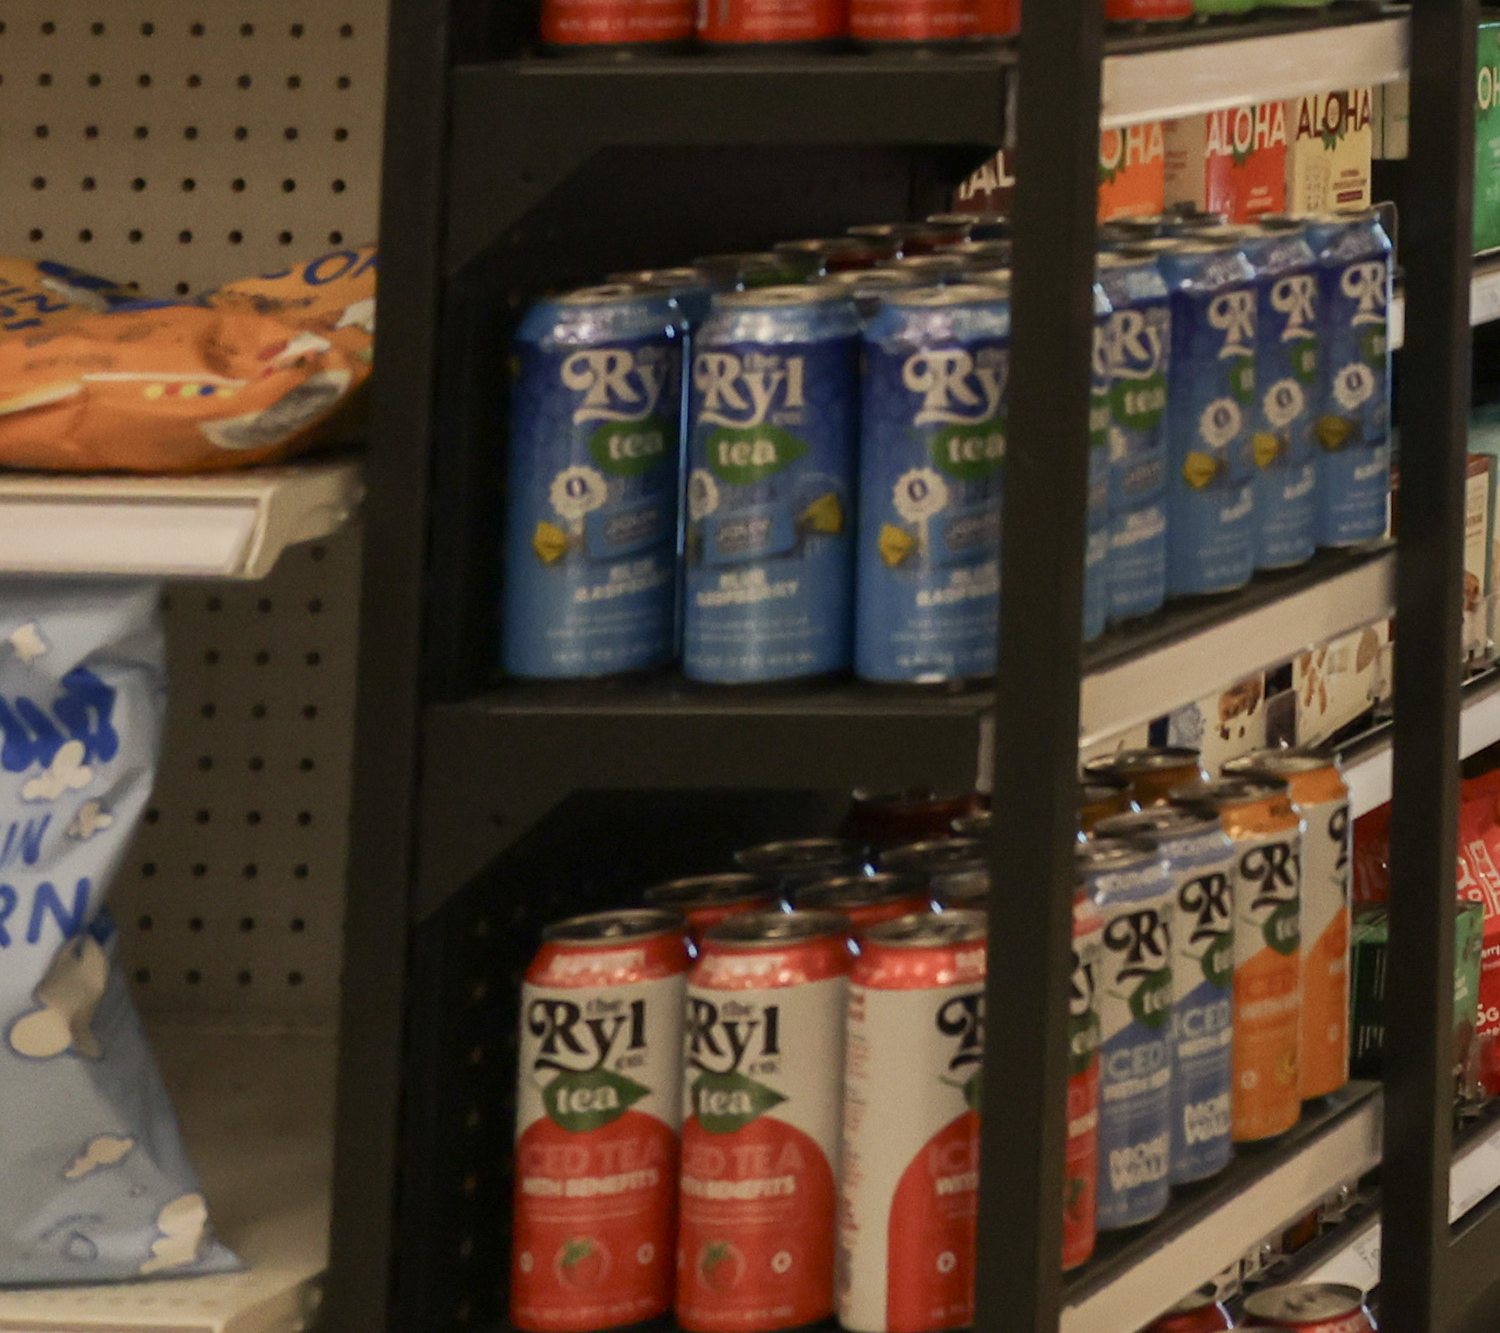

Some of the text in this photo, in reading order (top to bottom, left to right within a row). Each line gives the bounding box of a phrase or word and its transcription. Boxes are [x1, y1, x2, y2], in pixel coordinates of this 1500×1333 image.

[1205, 101, 1286, 158] ALOHA
[1296, 90, 1370, 141] ALOHA
[718, 436, 776, 465] tea
[529, 998, 646, 1072] Ryl
[556, 1085, 619, 1113] tea
[699, 1088, 753, 1114] tea
